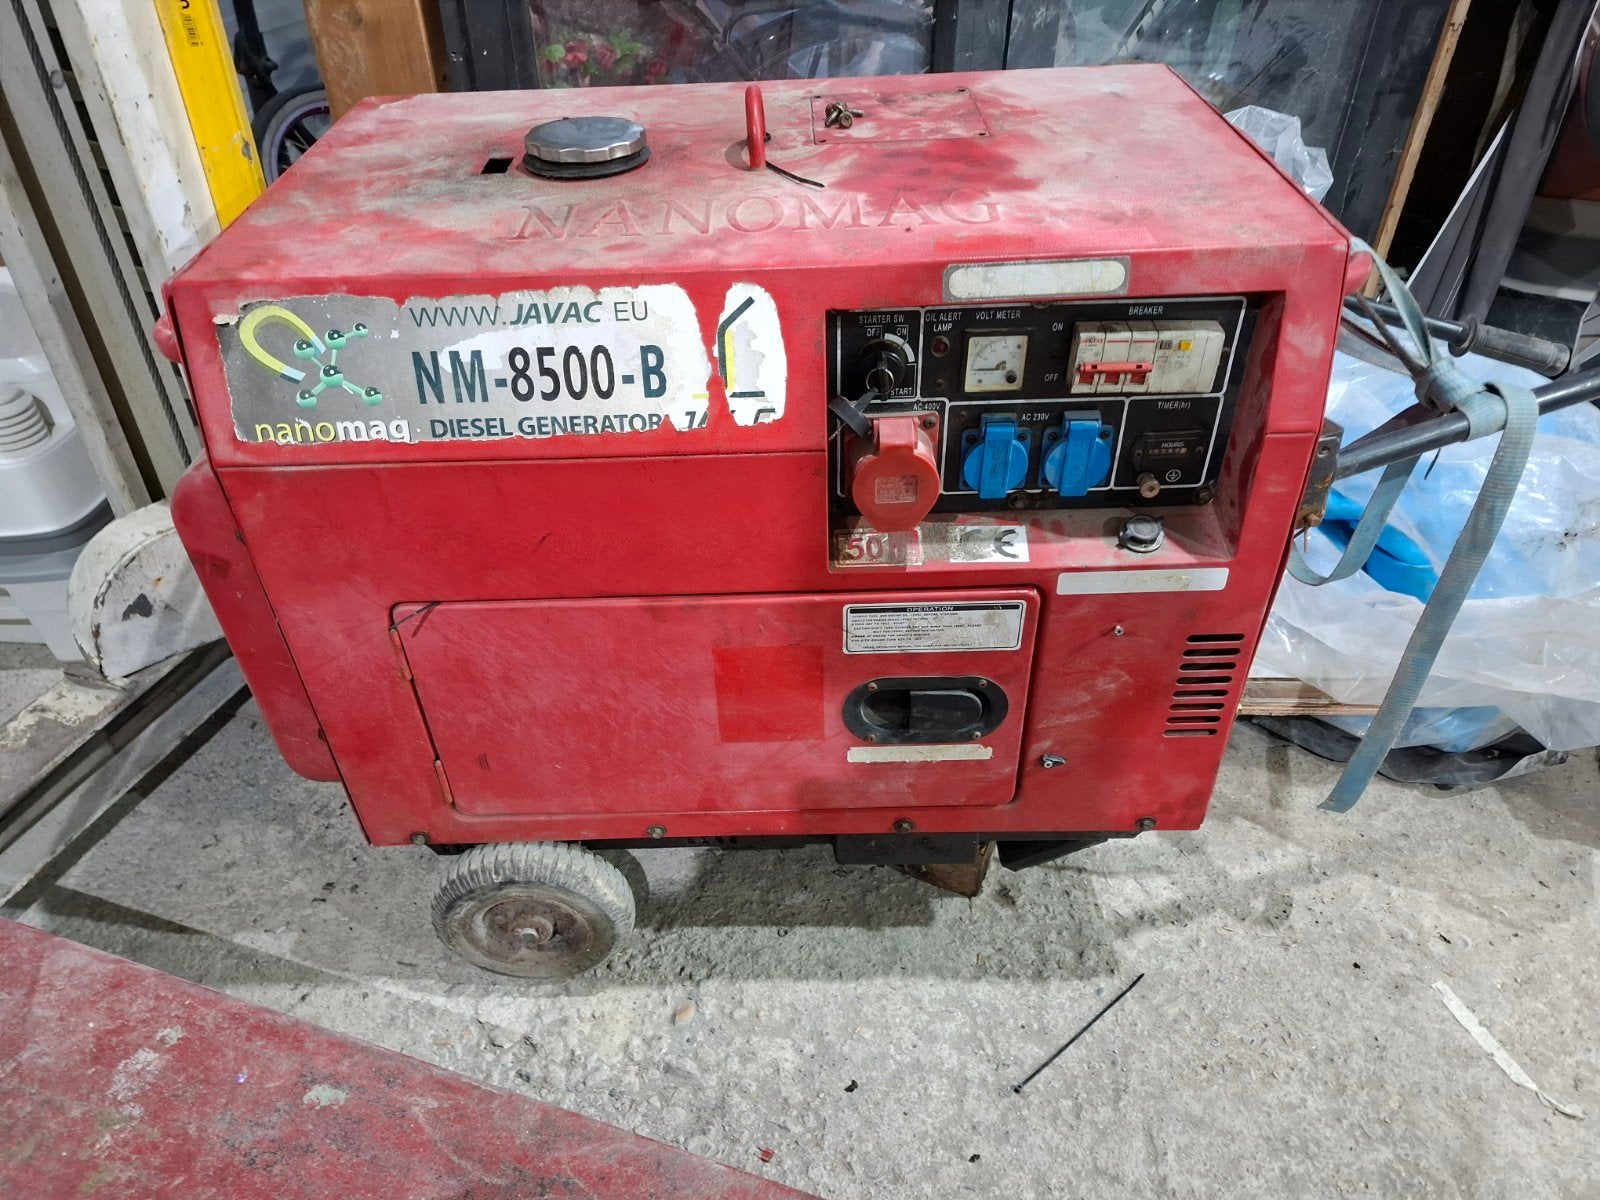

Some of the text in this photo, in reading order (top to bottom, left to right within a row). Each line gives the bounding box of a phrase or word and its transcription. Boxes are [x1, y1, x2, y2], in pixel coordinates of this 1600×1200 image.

[507, 187, 1003, 240] NANOMAG
[975, 309, 1021, 320] VOLT METER
[1128, 305, 1164, 315] BREAKER
[859, 314, 905, 324] STARTER SW
[925, 312, 962, 322] OIL ALERT
[896, 327, 907, 336] ON
[933, 322, 953, 332] LAMP
[1052, 322, 1064, 332] ON
[866, 328, 880, 337] OFF
[412, 344, 667, 404] NM-8500-B
[1044, 373, 1059, 382] OFF
[890, 387, 912, 396] START
[913, 402, 940, 411] AC 400V
[1021, 412, 1050, 421] AC 230V
[255, 418, 411, 444] nanomag
[430, 418, 513, 438] DIESEL
[1161, 441, 1185, 449] HOURS
